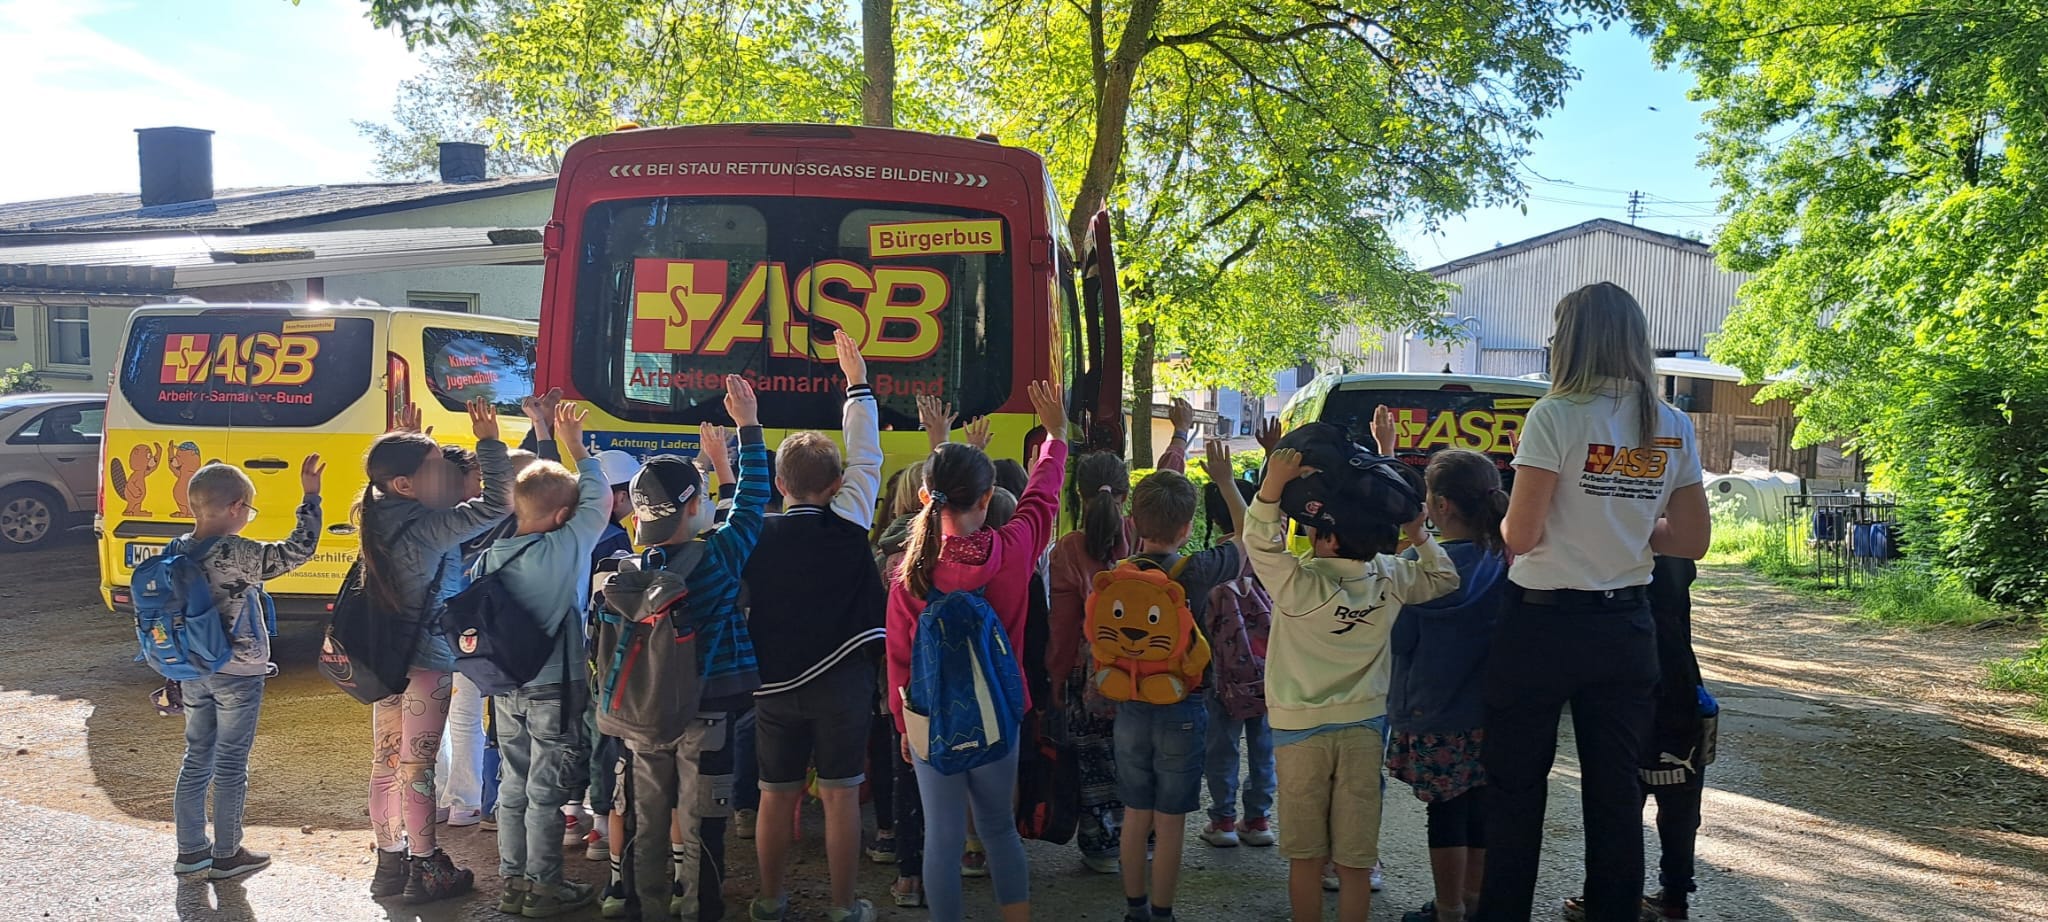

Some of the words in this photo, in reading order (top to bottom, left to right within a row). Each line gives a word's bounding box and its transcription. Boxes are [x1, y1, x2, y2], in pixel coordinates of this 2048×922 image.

[646, 164, 674, 176] BEI
[677, 163, 721, 175] STAU
[726, 162, 876, 179] RETTUNGSGASSE
[881, 167, 949, 184] BILDEN!
[879, 226, 993, 250] Bürgerbus
[695, 259, 951, 363] ASB
[190, 332, 320, 385] ASB
[446, 371, 498, 390] Jugendhilfe
[629, 366, 944, 396] ArbeiterSamaritBund
[610, 438, 658, 450] Achtung
[660, 439, 700, 450] Ladera
[1418, 410, 1526, 454] ASB
[1604, 446, 1668, 478] ASB
